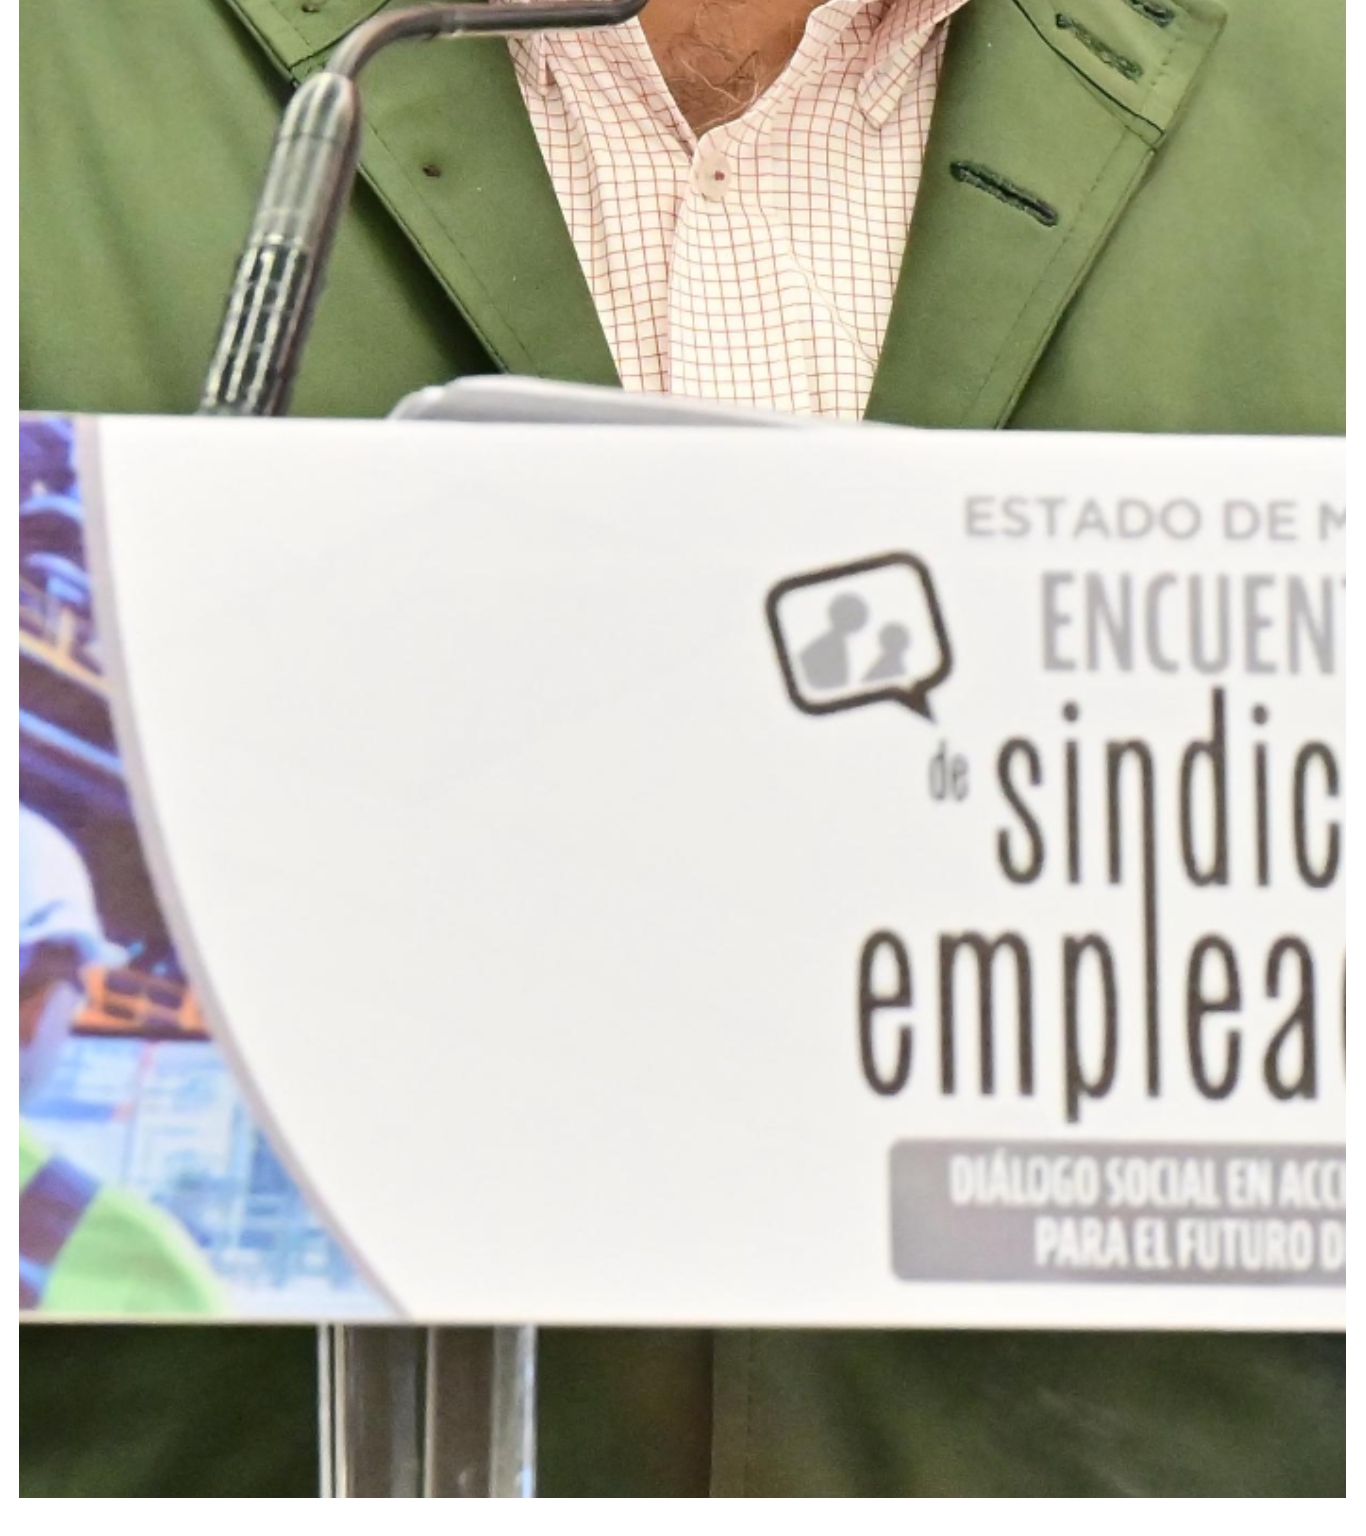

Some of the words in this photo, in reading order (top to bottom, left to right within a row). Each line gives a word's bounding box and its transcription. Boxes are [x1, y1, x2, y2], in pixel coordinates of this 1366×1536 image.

[965, 495, 1202, 541] ESTADO
[1223, 498, 1297, 542] DE
[1041, 571, 1346, 676] ENCUEN
[927, 740, 970, 804] de
[994, 685, 1344, 890] sindic
[855, 914, 1346, 1126] emplea
[949, 1148, 1099, 1206] DIÁLOGO
[1105, 1157, 1220, 1207] SOCIAL
[1226, 1159, 1273, 1208] EN
[1035, 1215, 1131, 1268] PARA
[1134, 1216, 1173, 1269] EL
[1176, 1218, 1315, 1272] FUTURO
